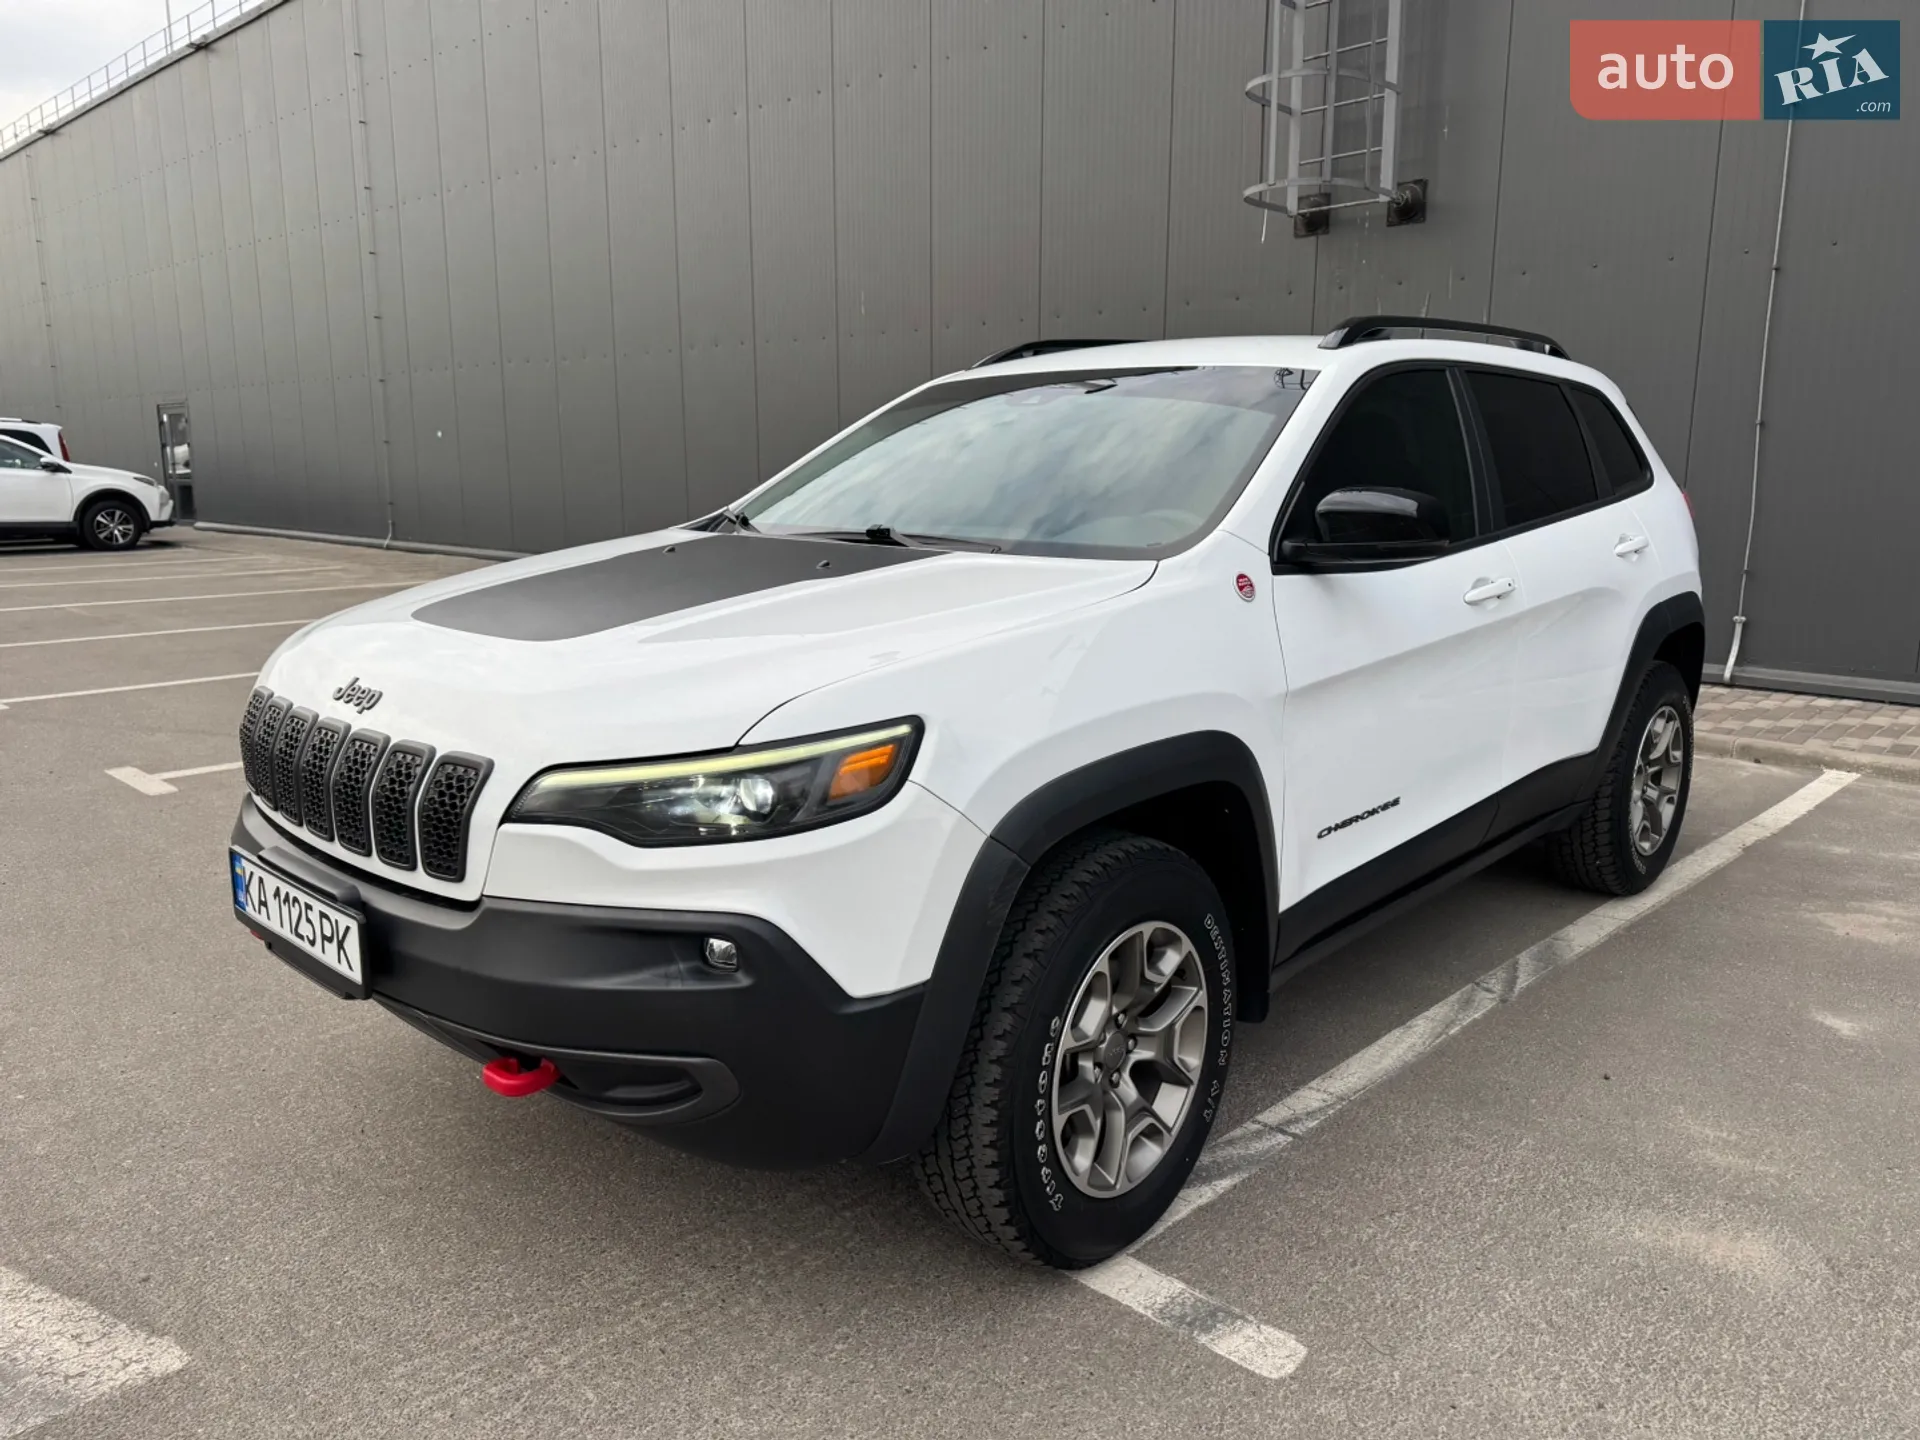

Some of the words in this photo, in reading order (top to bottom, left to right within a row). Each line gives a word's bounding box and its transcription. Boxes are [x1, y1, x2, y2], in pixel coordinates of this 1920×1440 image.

[332, 677, 383, 714] Jeep
[1317, 796, 1401, 839] CHEROKEE
[243, 866, 271, 921] KA
[273, 886, 316, 948] 1125
[319, 910, 354, 972] PK
[1204, 913, 1232, 1066] DESTINATION
